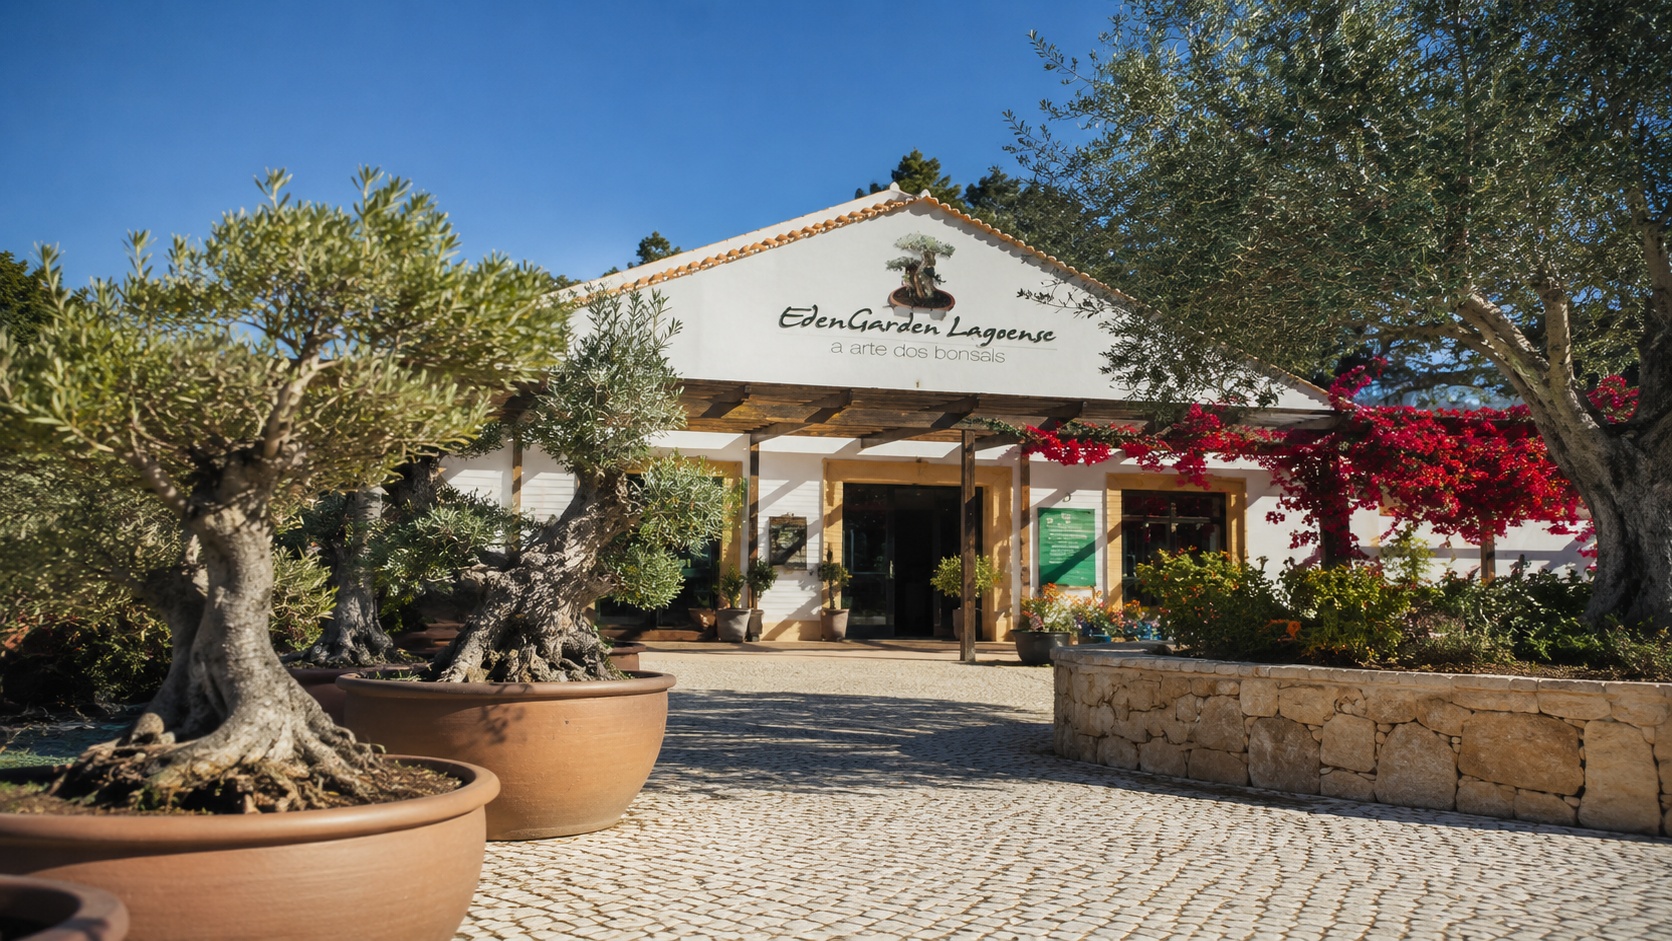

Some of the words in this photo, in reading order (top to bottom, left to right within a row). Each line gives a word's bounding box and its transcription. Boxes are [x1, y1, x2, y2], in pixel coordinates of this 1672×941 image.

[779, 304, 940, 335] EdenGarden
[946, 316, 1057, 347] Lagoense
[830, 342, 843, 354] a
[849, 342, 887, 356] arte
[893, 344, 928, 359] dos
